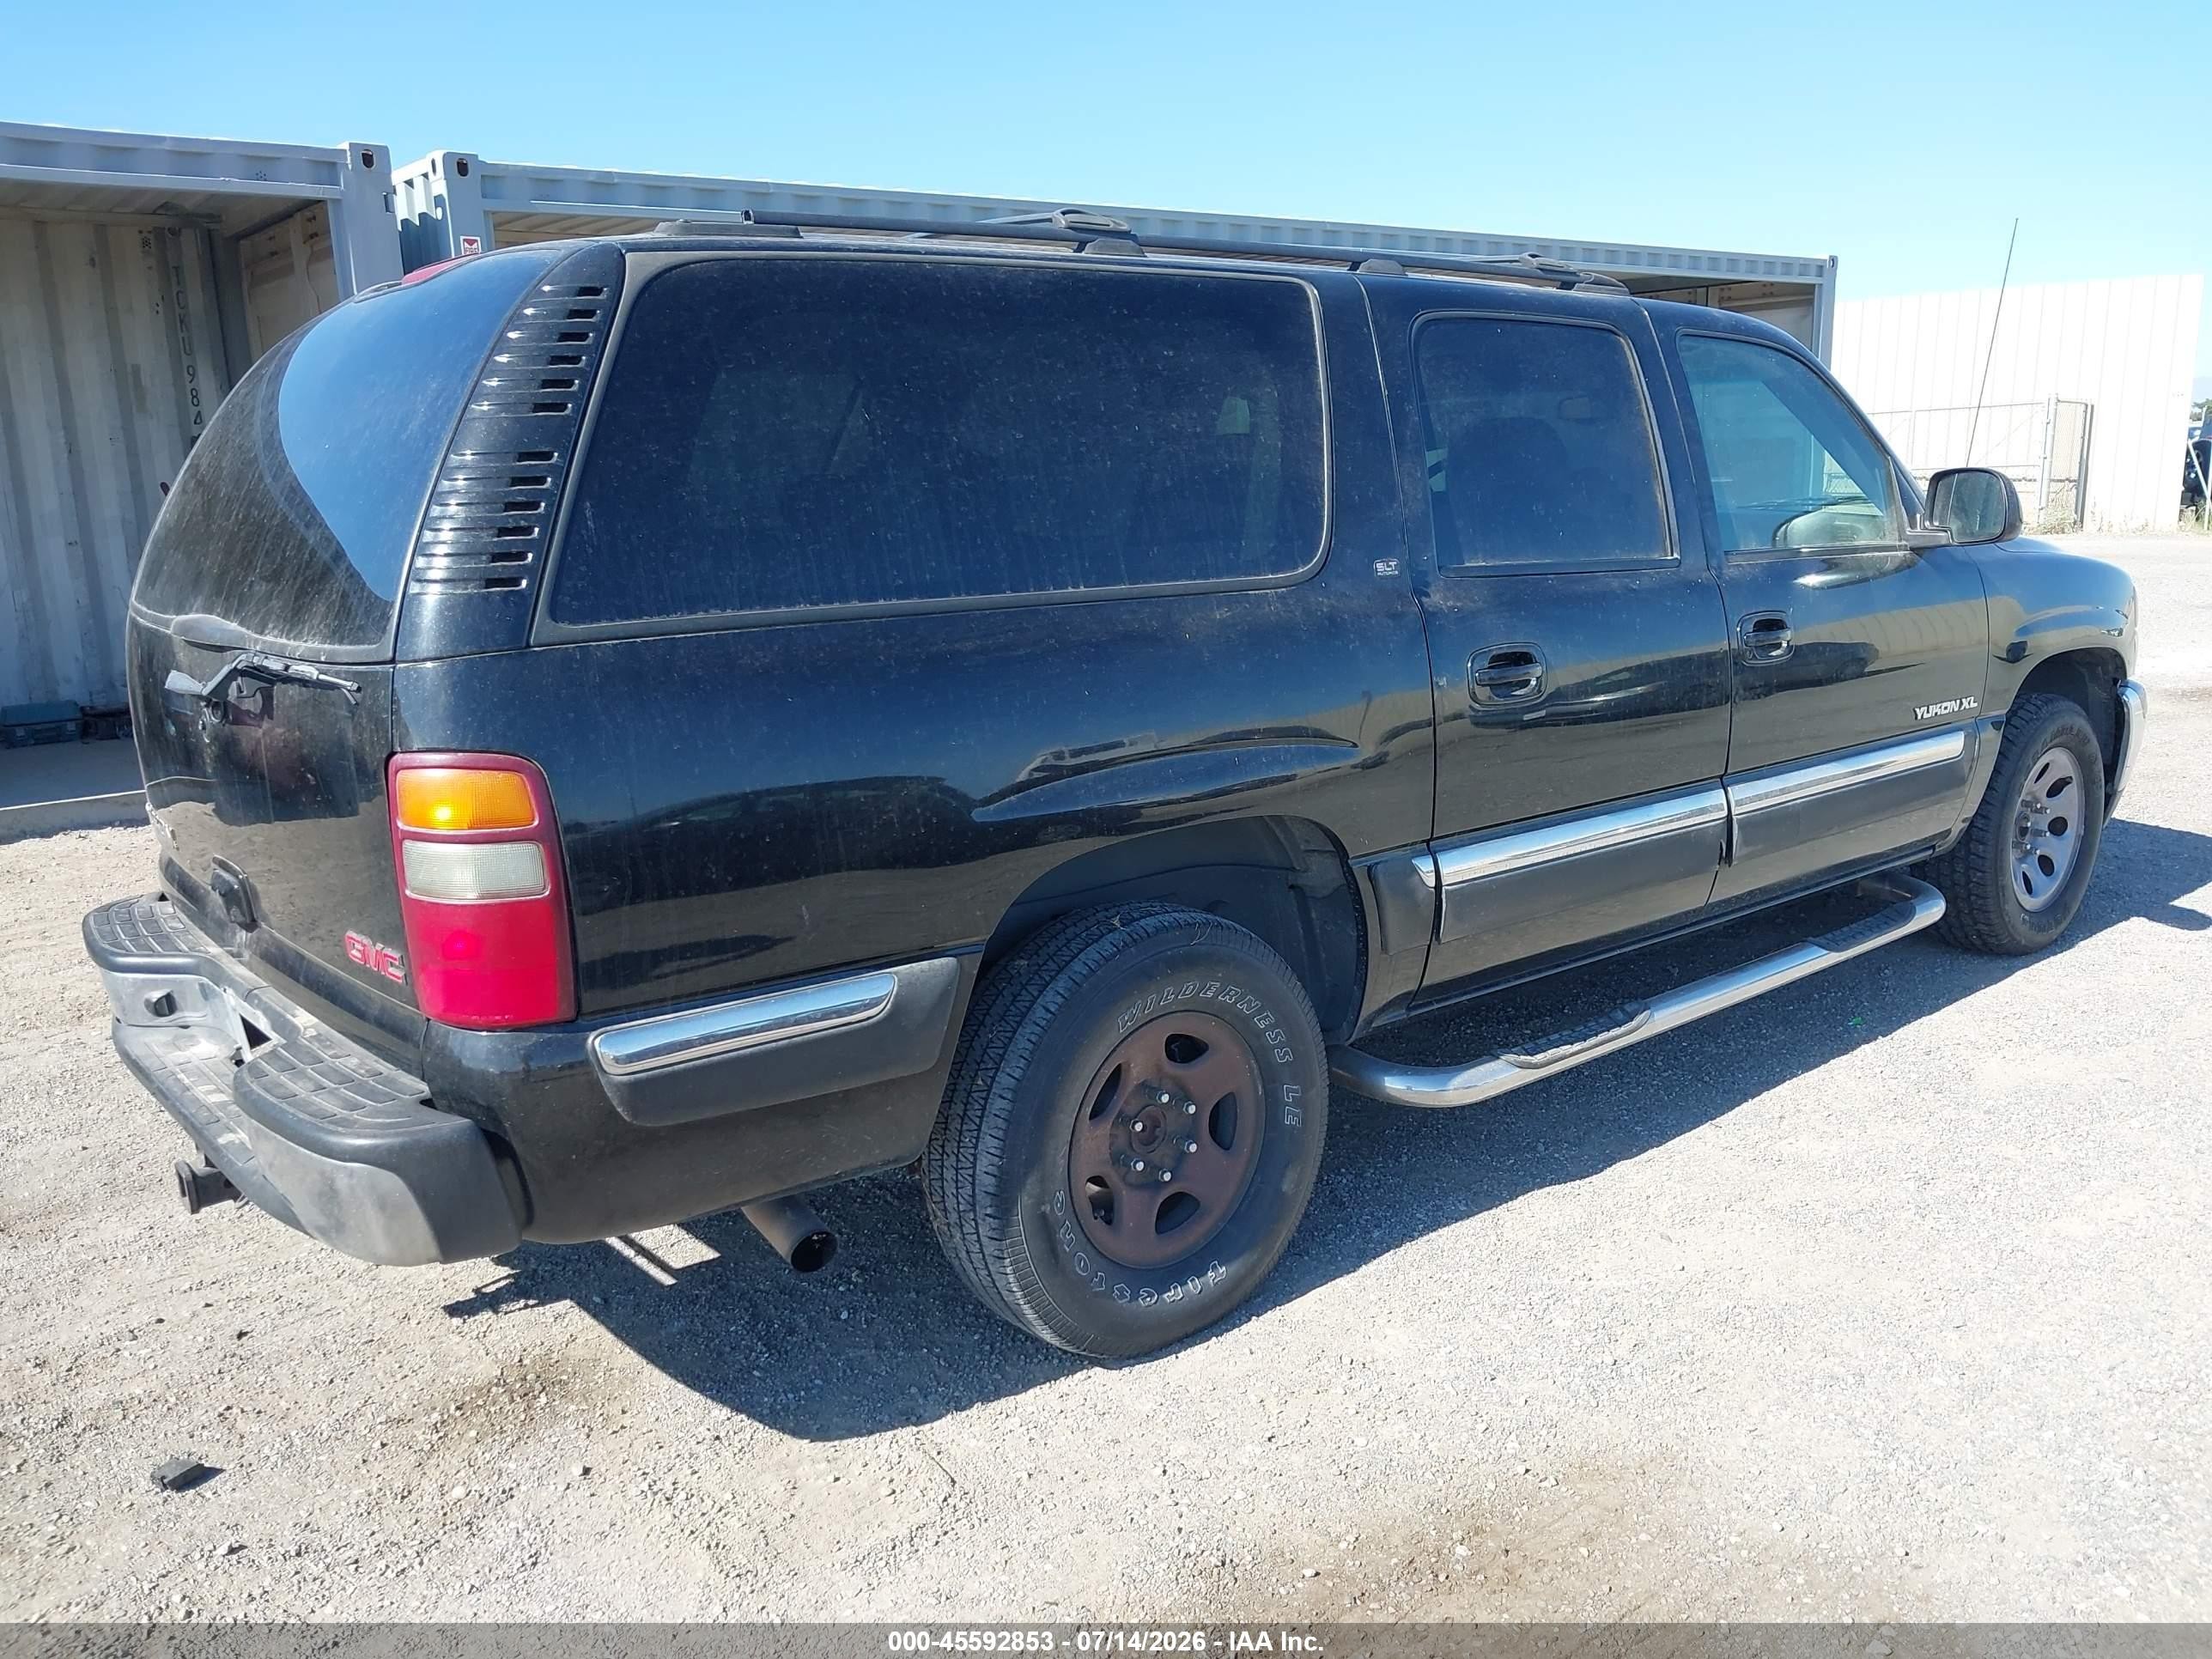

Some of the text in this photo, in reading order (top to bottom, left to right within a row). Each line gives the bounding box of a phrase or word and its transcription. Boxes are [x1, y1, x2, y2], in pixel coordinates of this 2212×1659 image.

[1376, 562, 1397, 572] SLT
[1913, 696, 1978, 720] YUKON XL
[345, 929, 408, 985] GMC
[1117, 981, 1302, 1127] WILDERNESS LE
